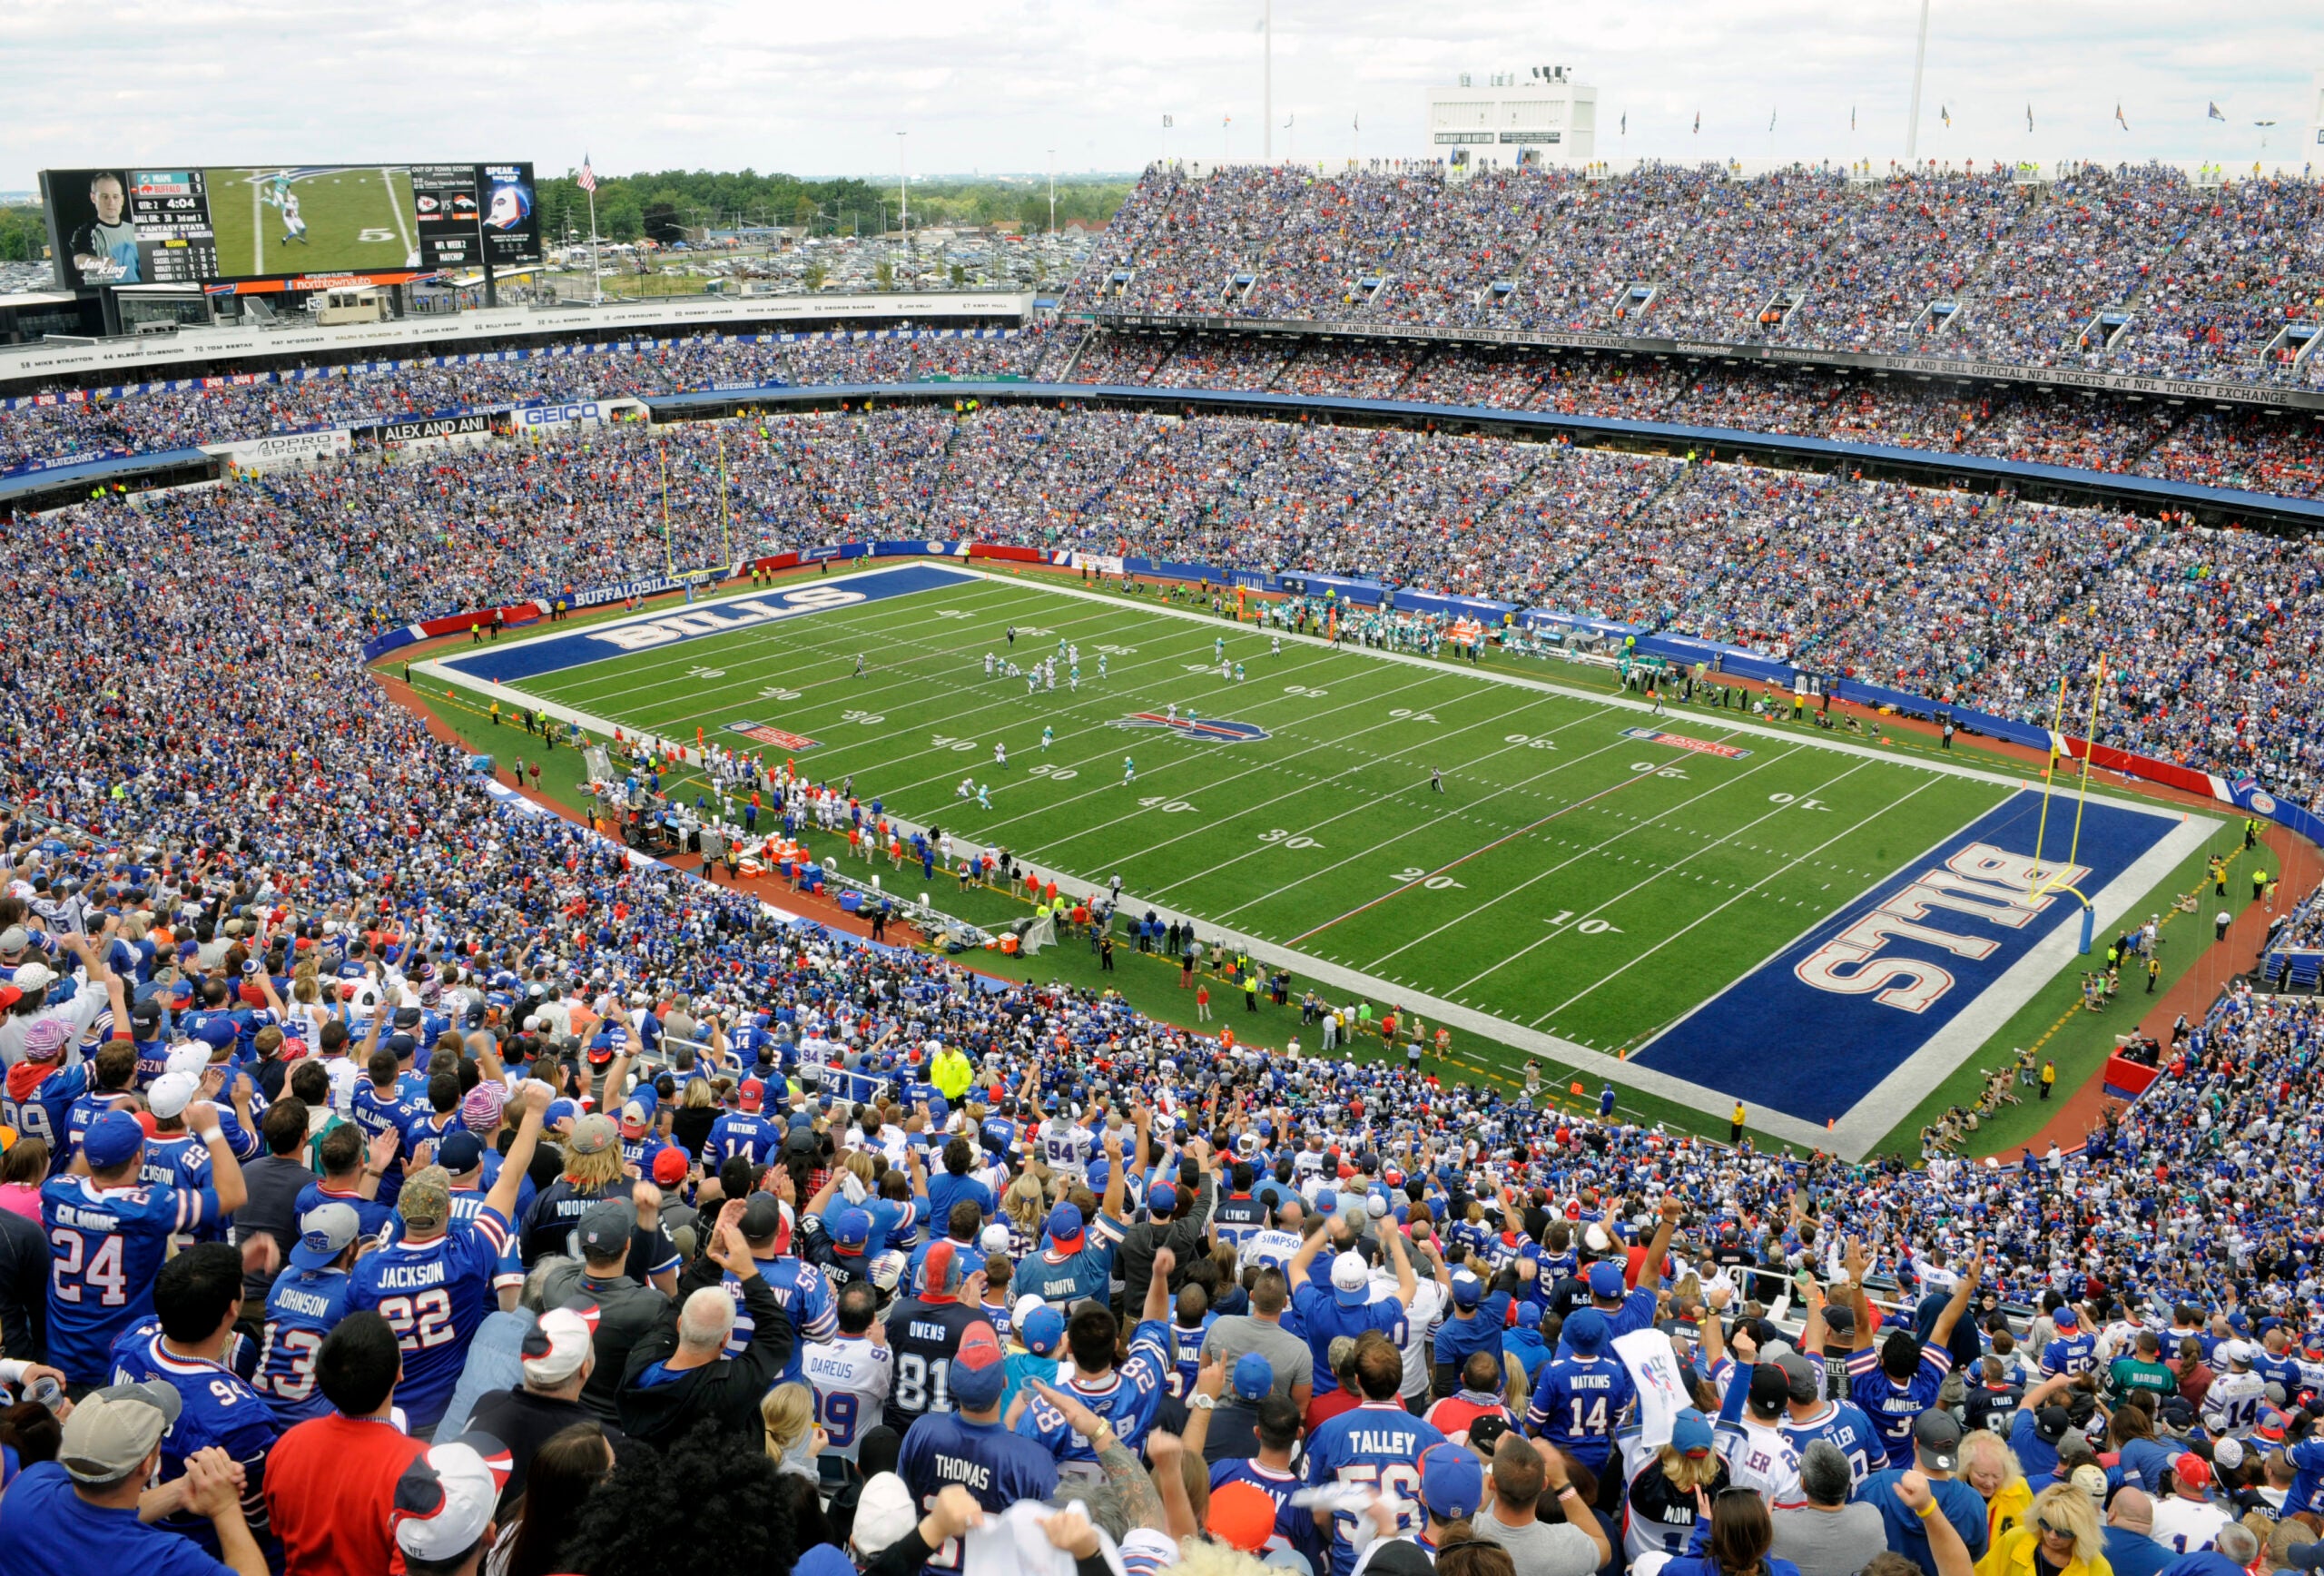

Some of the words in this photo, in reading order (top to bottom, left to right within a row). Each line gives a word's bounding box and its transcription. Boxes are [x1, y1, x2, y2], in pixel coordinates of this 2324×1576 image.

[153, 172, 172, 182] MIAMI
[194, 172, 201, 182] 0
[486, 166, 513, 176] SPEAK
[154, 183, 181, 193] BUFFALO
[196, 184, 202, 193] 9
[167, 198, 196, 208] 4:04
[441, 200, 452, 211] VS
[141, 224, 178, 233] FANTASY
[180, 223, 206, 231] STATS
[358, 228, 395, 242] 5
[435, 241, 445, 250] NFL
[447, 241, 461, 249] WEEK
[439, 253, 465, 262] MATCHUP
[296, 277, 371, 290] northtownauto
[1326, 324, 1344, 333] BUY
[1347, 325, 1365, 334] AND
[1369, 326, 1390, 335] SELL
[1393, 328, 1433, 337] OFFICIAL
[1437, 330, 1454, 338] NFL
[1457, 331, 1497, 340] TICKETS
[1502, 333, 1514, 341] AT
[1517, 334, 1535, 342] NFL
[1541, 335, 1575, 345] TICKET
[1578, 337, 1630, 348] EXCHANGE
[505, 351, 518, 360] 201
[1677, 342, 1733, 355] ticketmaster
[1784, 351, 1811, 360] RESALE
[1812, 353, 1835, 362] RIGHT
[56, 356, 94, 364] STRATTON
[1886, 358, 1907, 368] BUY
[1913, 360, 1937, 371] AND
[1941, 362, 1968, 374] SELL
[1972, 365, 2023, 378] OFFICIAL
[2028, 369, 2050, 381] NFL
[2055, 372, 2106, 386] TICKETS
[2113, 377, 2129, 388] AT
[2134, 379, 2157, 391] NFL
[2165, 382, 2211, 396] TICKET
[2216, 386, 2288, 404] EXCHANGE
[15, 396, 32, 409] Blue
[39, 394, 57, 406] 242
[65, 391, 84, 402] 243
[122, 384, 139, 397] Blue
[232, 374, 251, 385] 244
[473, 403, 516, 414] BLUEZONE
[525, 402, 599, 425] GEICO
[336, 417, 383, 430] BLUEZONE
[385, 423, 422, 441] ALEX
[424, 419, 456, 435] AND
[459, 416, 484, 432] ANI
[262, 443, 335, 457] SPORTS
[46, 453, 95, 468] BLUEZONE
[586, 586, 866, 649] BILLS
[686, 665, 726, 679] 10
[758, 687, 802, 700] 20
[841, 709, 885, 724] 30
[931, 734, 977, 751] 40
[1657, 739, 1727, 756] FOOTBALL
[1664, 735, 1707, 748] BACK
[1713, 744, 1736, 754] TO
[1029, 763, 1078, 780] 50
[1630, 762, 1686, 778] 20
[1137, 796, 1190, 813] 40
[1769, 793, 1826, 810] 10
[2255, 797, 2271, 808] RCW
[1258, 829, 1314, 848] 30
[1389, 868, 1454, 890] 20
[1544, 910, 1609, 934] 10
[1793, 842, 2092, 1014] BILLS
[736, 1035, 750, 1049] 14
[803, 1050, 818, 1062] 94
[248, 1090, 270, 1115] 12
[73, 1108, 89, 1123] THE
[355, 1105, 393, 1129] WILLIAMS
[727, 1122, 757, 1135] WATKINS
[182, 1144, 211, 1170] 22
[725, 1138, 754, 1167] 14
[1048, 1141, 1074, 1162] 94
[56, 1204, 120, 1231] GILMORE
[1226, 1209, 1251, 1221] LYNCH
[51, 1228, 128, 1306] 24
[377, 1261, 444, 1289] JACKSON
[819, 1262, 849, 1284] SPIKES
[1044, 1278, 1075, 1296] SMITH
[274, 1286, 330, 1320] JOHNSON
[378, 1287, 455, 1349] 22
[909, 1320, 945, 1342] OWENS
[2067, 1346, 2088, 1356] ALONSO
[251, 1320, 323, 1401] 13
[811, 1357, 852, 1379] DAREUS
[1569, 1375, 1610, 1390] WATKINS
[2133, 1372, 2163, 1385] MARINO
[2265, 1369, 2286, 1380] MANUEL
[897, 1352, 954, 1415] 81
[210, 1379, 251, 1407] 94
[1991, 1396, 2013, 1407] EVANS
[1883, 1398, 1923, 1412] MANUEL
[2228, 1399, 2256, 1428] 14
[1569, 1396, 1608, 1438] 14
[1886, 1415, 1913, 1438] 3
[1349, 1431, 1416, 1455] TALLEY
[935, 1454, 990, 1490] THOMAS
[1334, 1463, 1423, 1545] 56
[1663, 1504, 1691, 1524] MOM
[408, 1545, 424, 1557] NFL
